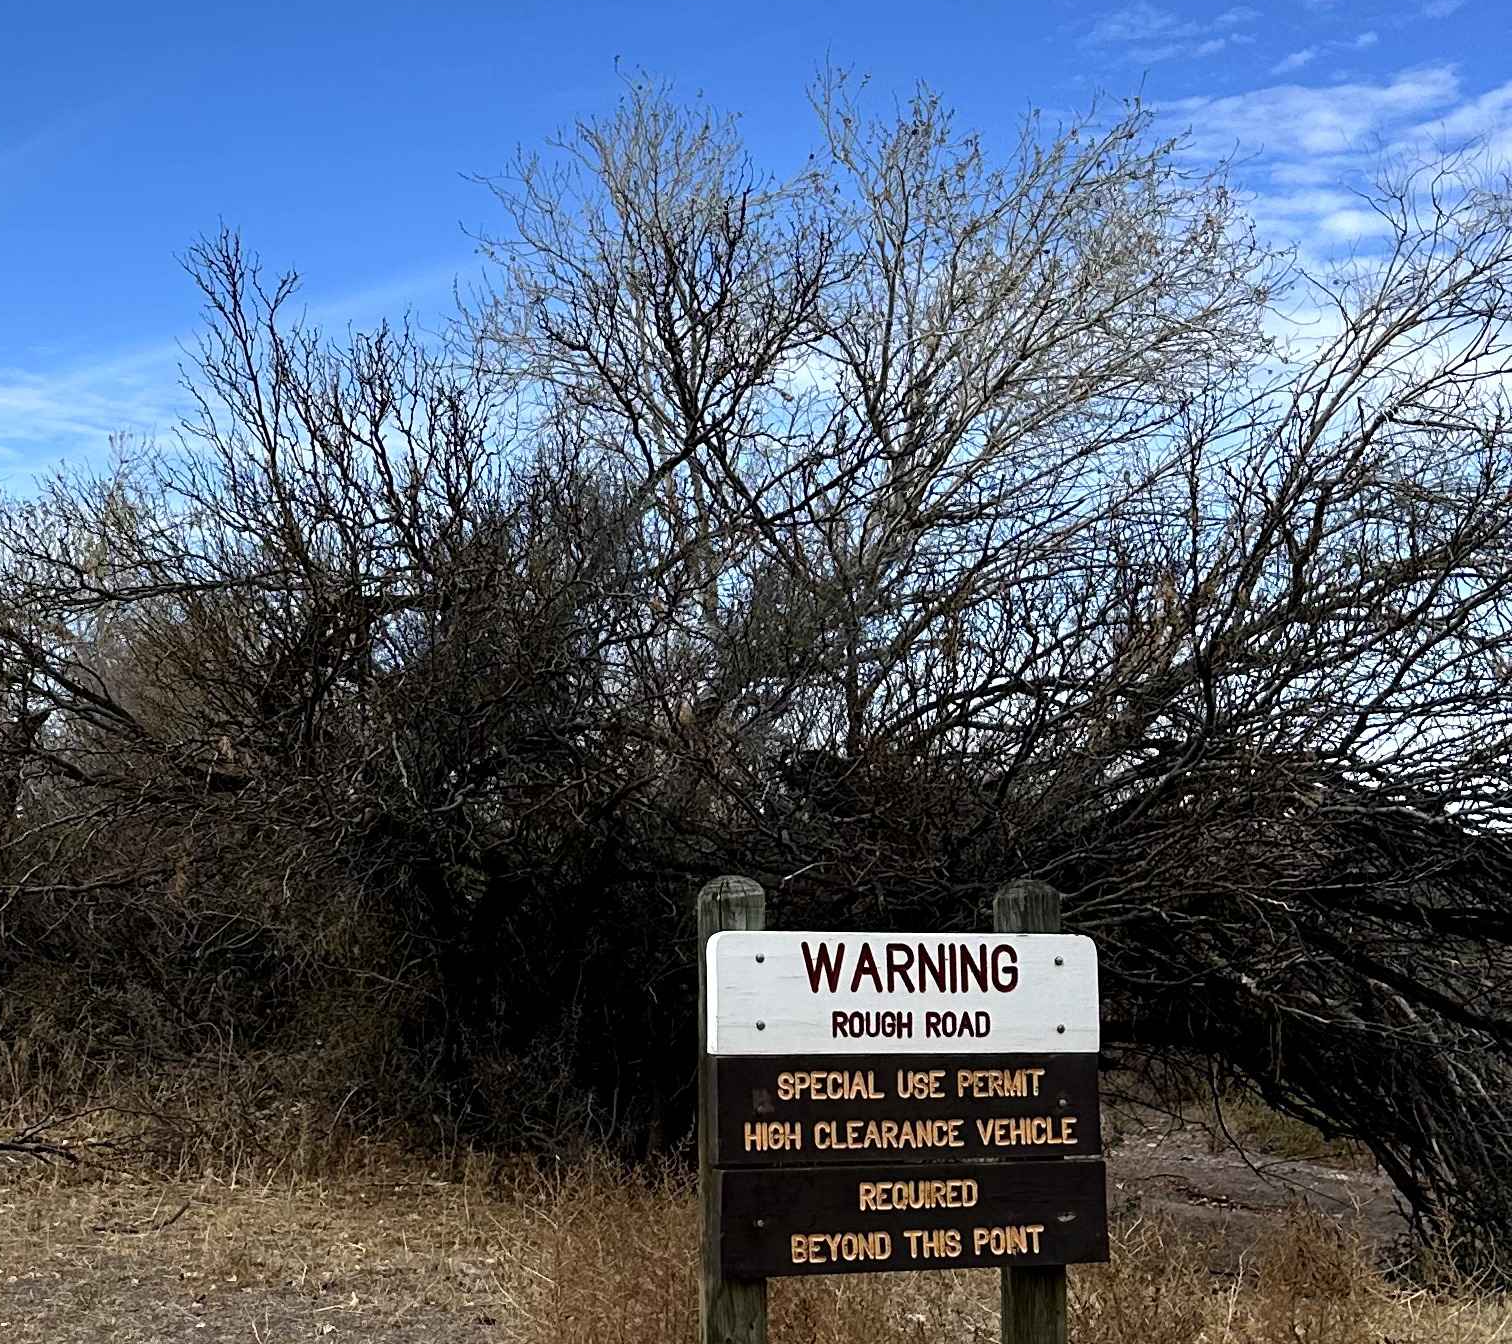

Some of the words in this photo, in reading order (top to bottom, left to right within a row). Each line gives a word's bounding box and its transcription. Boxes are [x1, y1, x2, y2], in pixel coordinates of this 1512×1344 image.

[801, 941, 1019, 994] WARNING
[832, 1011, 913, 1039] ROUGH
[925, 1011, 991, 1038] ROAD
[777, 1070, 884, 1101] SPECIAL
[897, 1069, 946, 1098] USE
[957, 1068, 1045, 1097] PERMIT
[744, 1121, 802, 1152] HIGH
[814, 1119, 964, 1150] CLEARANCE
[975, 1117, 1078, 1146] VEHICLE
[859, 1179, 978, 1211] REQUIRED
[791, 1231, 891, 1264] BEYOND
[904, 1228, 962, 1259] THIS
[974, 1225, 1045, 1256] POINT
